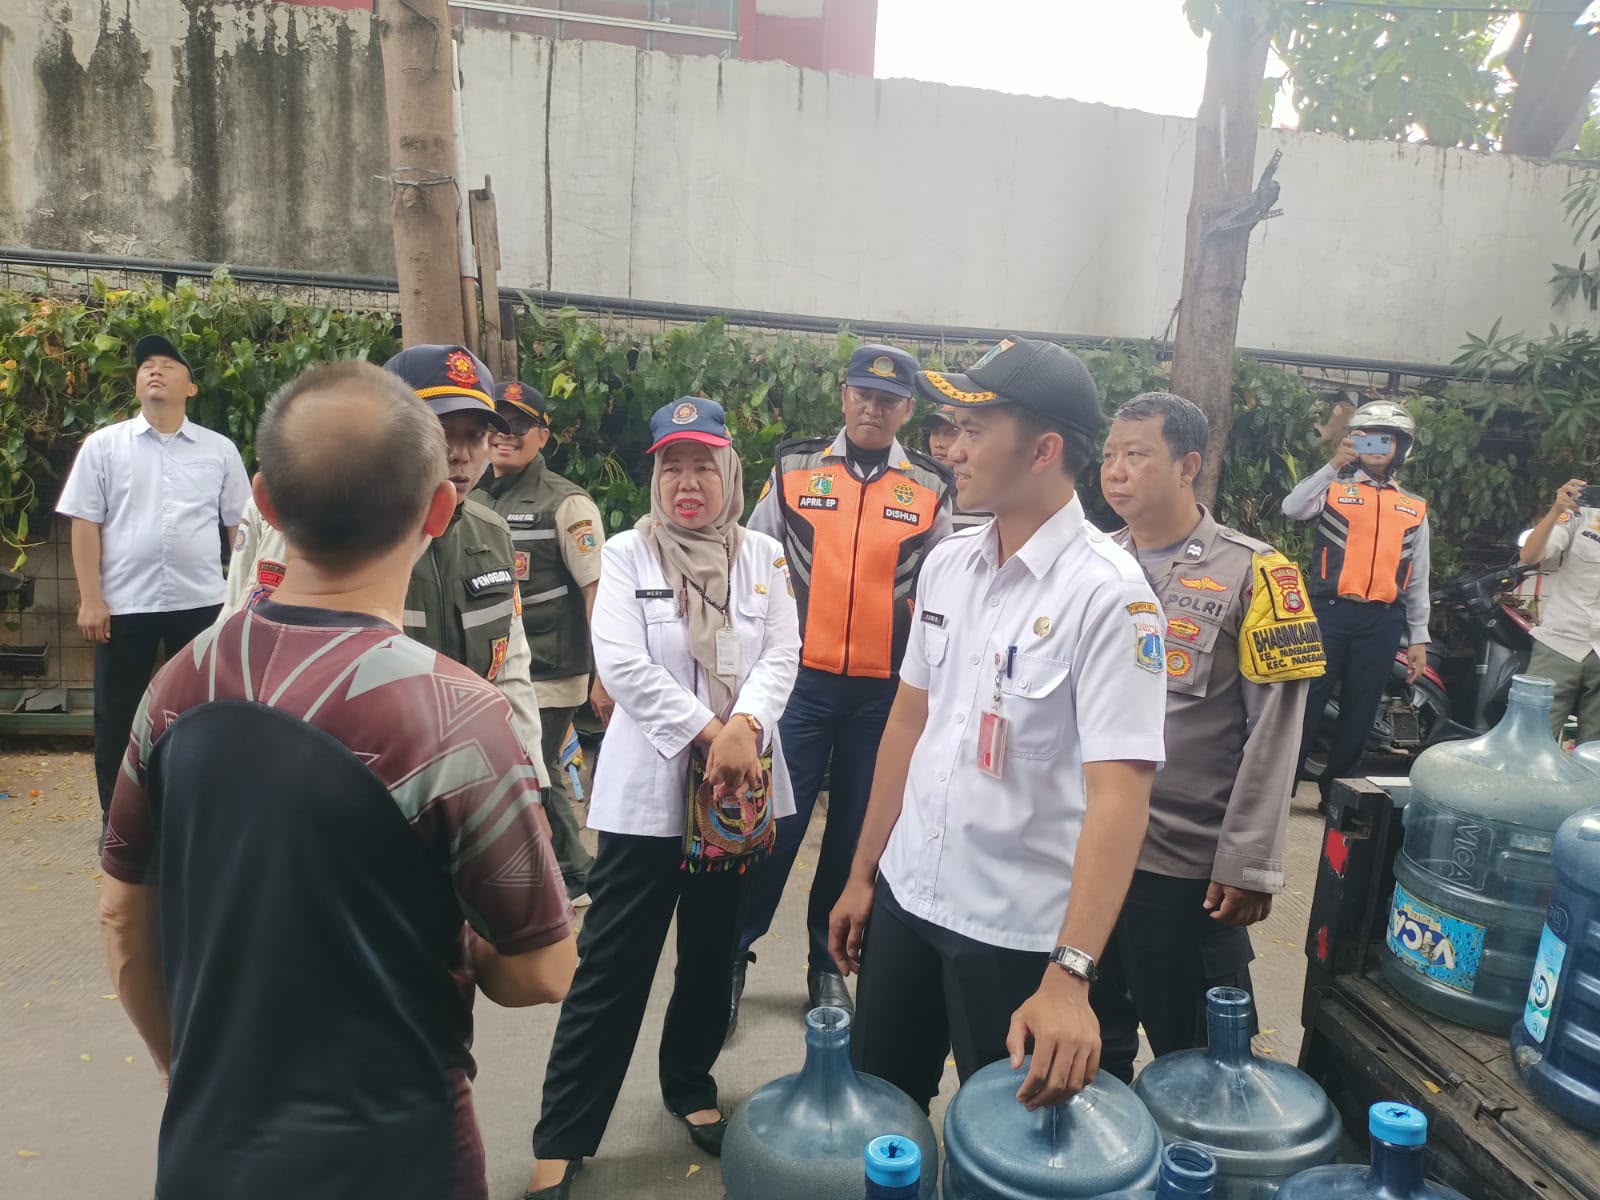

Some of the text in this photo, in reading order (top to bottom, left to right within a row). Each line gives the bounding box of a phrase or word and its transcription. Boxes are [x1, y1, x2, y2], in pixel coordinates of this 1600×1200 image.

[800, 497, 836, 508] APRIL EP
[885, 508, 918, 523] DISHUB
[1165, 593, 1223, 617] POLRI
[1266, 660, 1288, 670] KEC.
[1393, 908, 1455, 970] VICA
